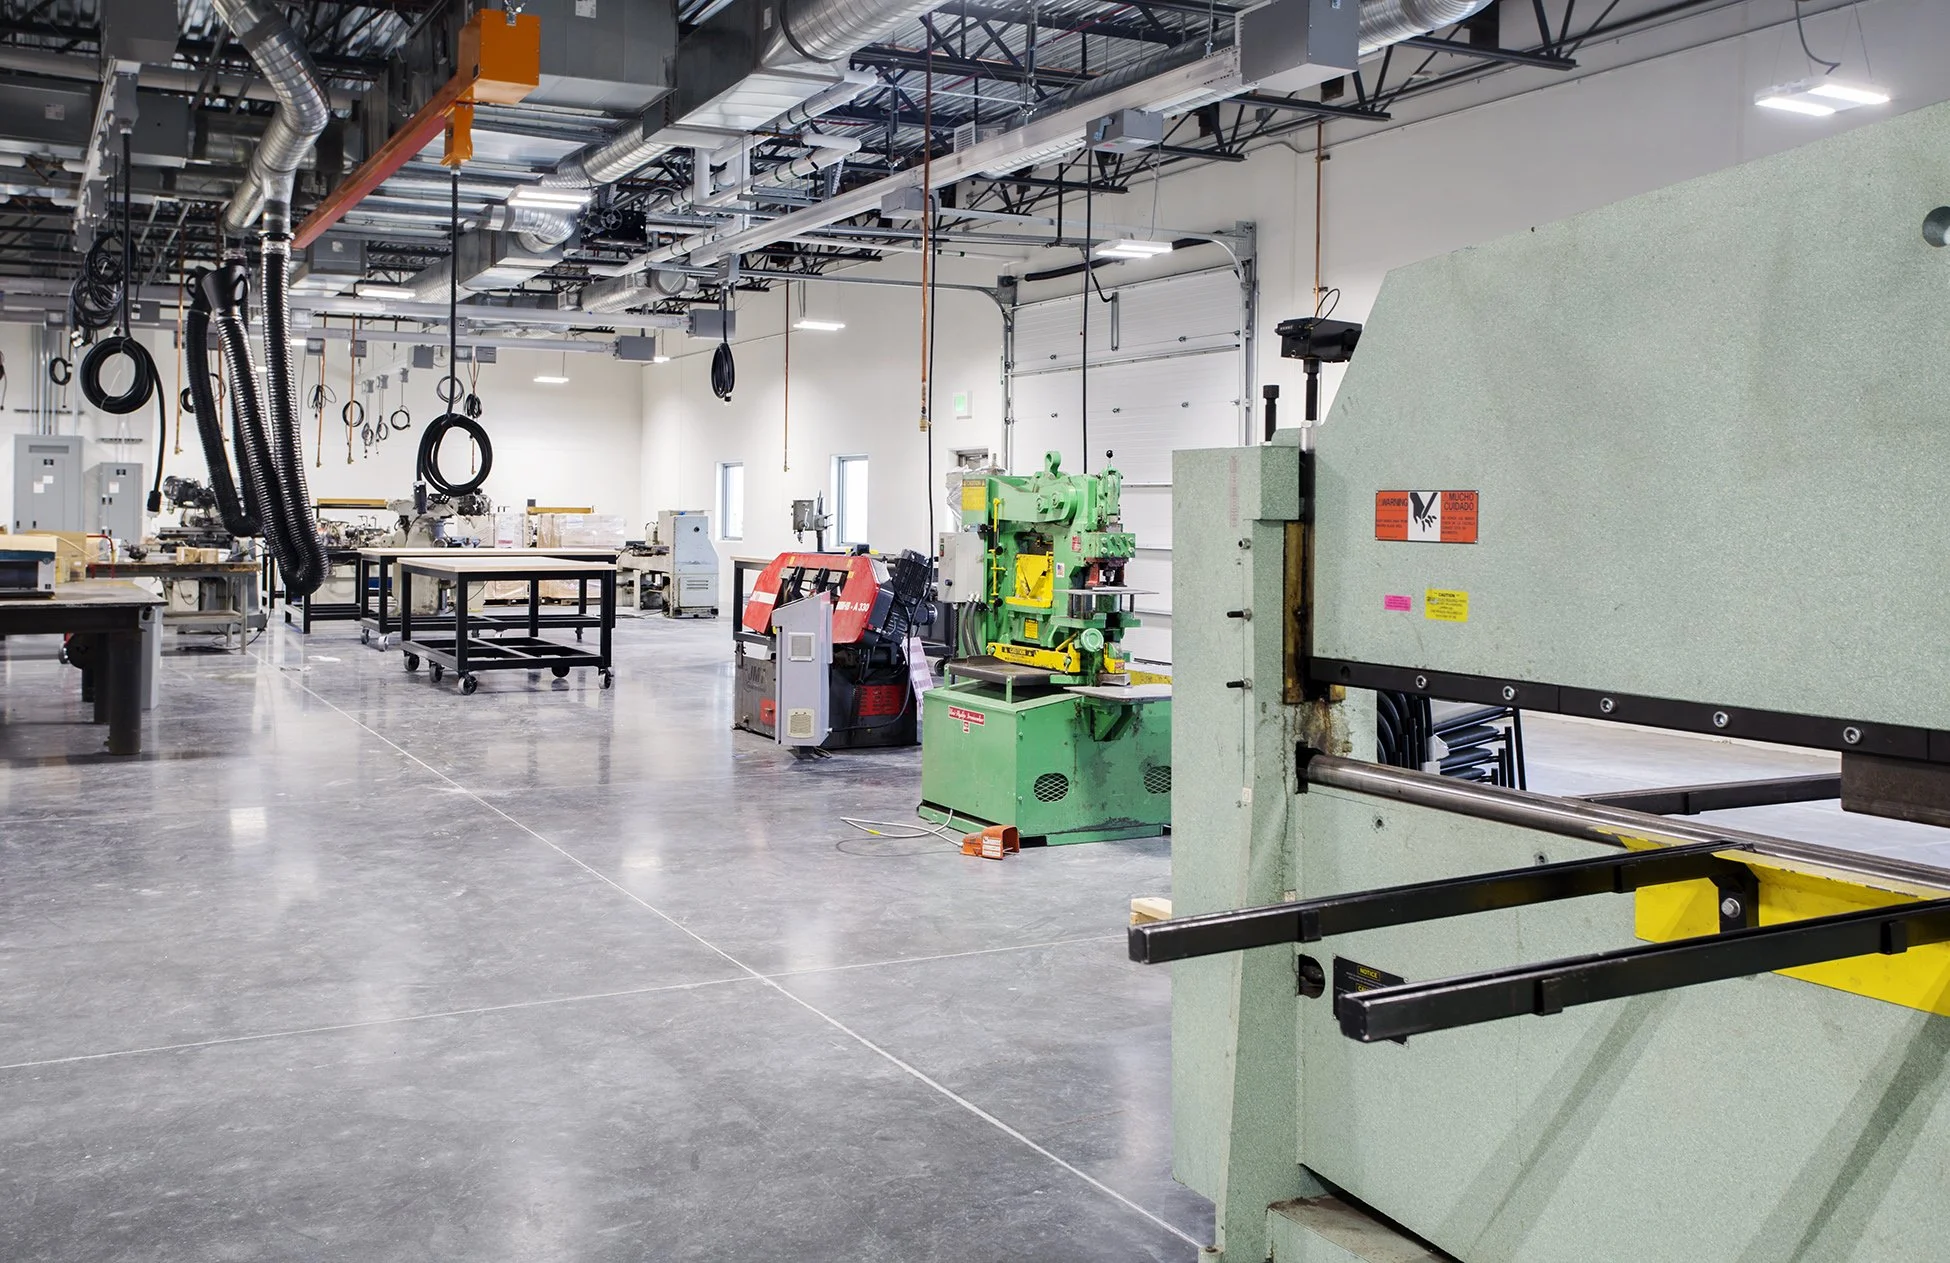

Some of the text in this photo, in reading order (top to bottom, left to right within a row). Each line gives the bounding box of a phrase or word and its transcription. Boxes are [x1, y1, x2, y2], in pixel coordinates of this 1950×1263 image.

[1449, 492, 1474, 501] MUCHO
[1382, 498, 1408, 507] WARNING
[1444, 502, 1474, 511] CUIDADO
[1359, 967, 1378, 979] NOTICE
